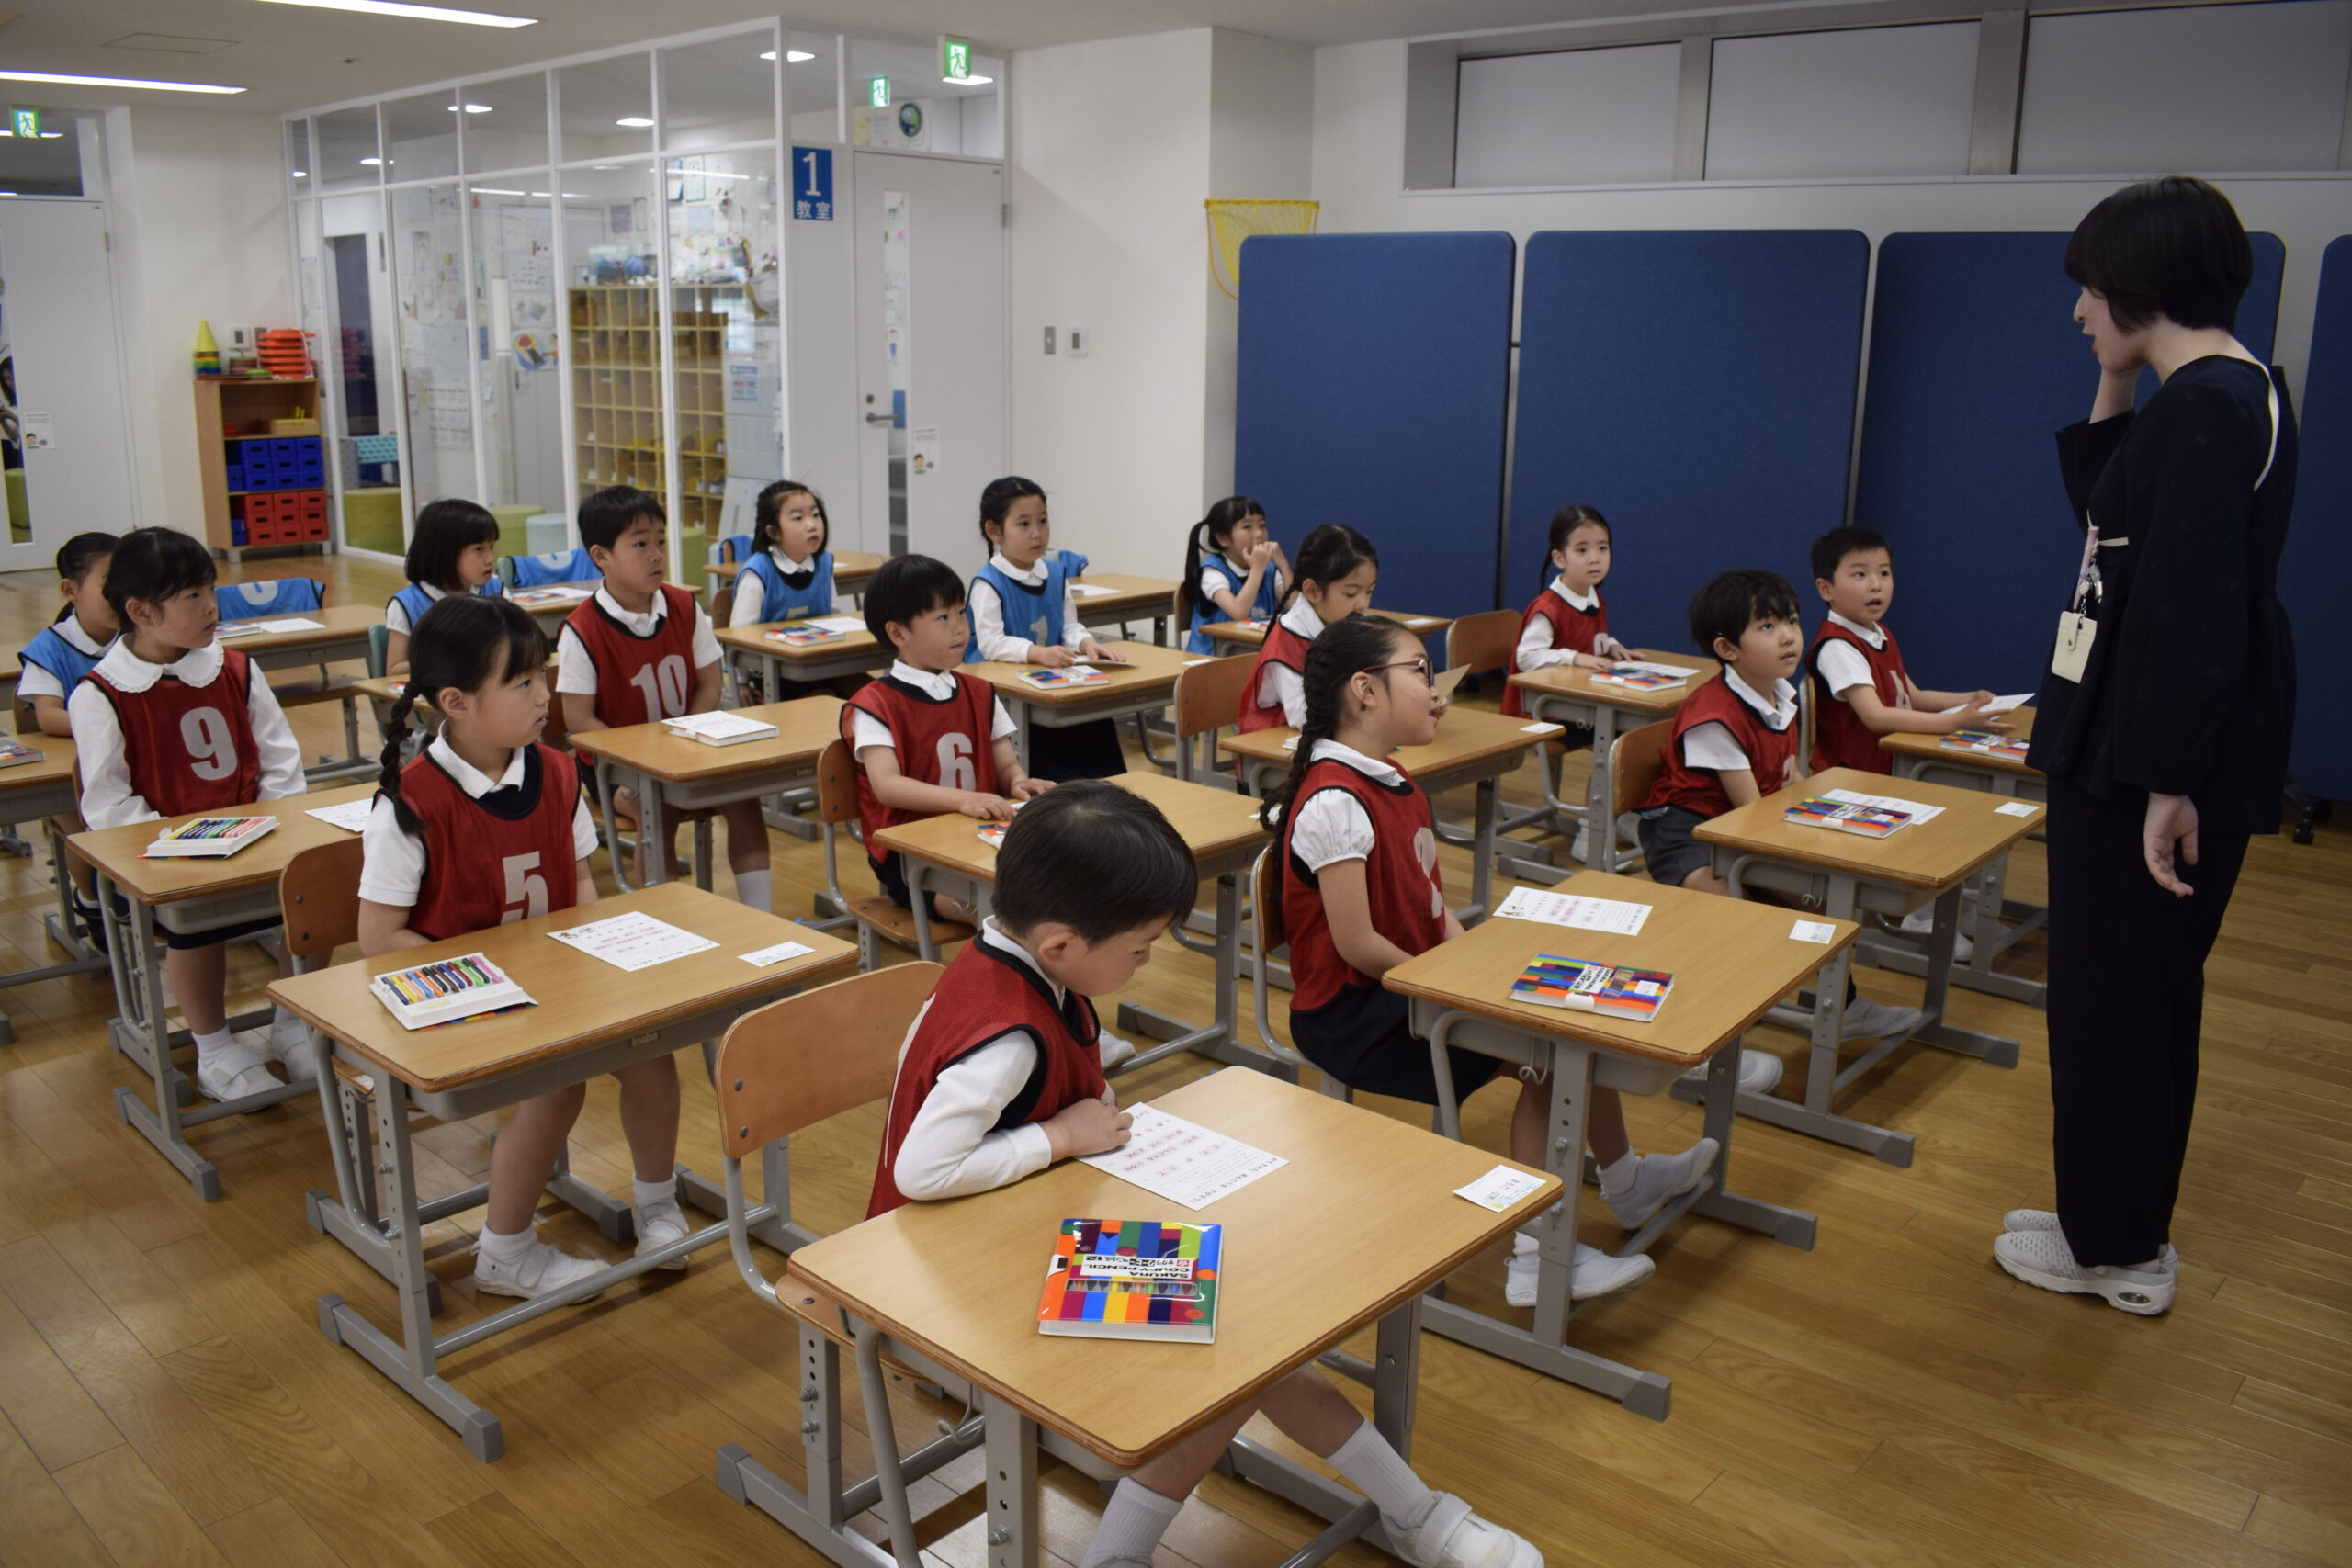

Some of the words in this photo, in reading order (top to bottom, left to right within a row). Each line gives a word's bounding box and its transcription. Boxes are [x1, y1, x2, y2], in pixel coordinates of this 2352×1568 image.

[802, 152, 821, 197] 1
[796, 200, 831, 220] 教室
[630, 654, 687, 722] 10
[179, 705, 237, 781] 9
[936, 732, 977, 792] 6
[500, 850, 549, 926] 5
